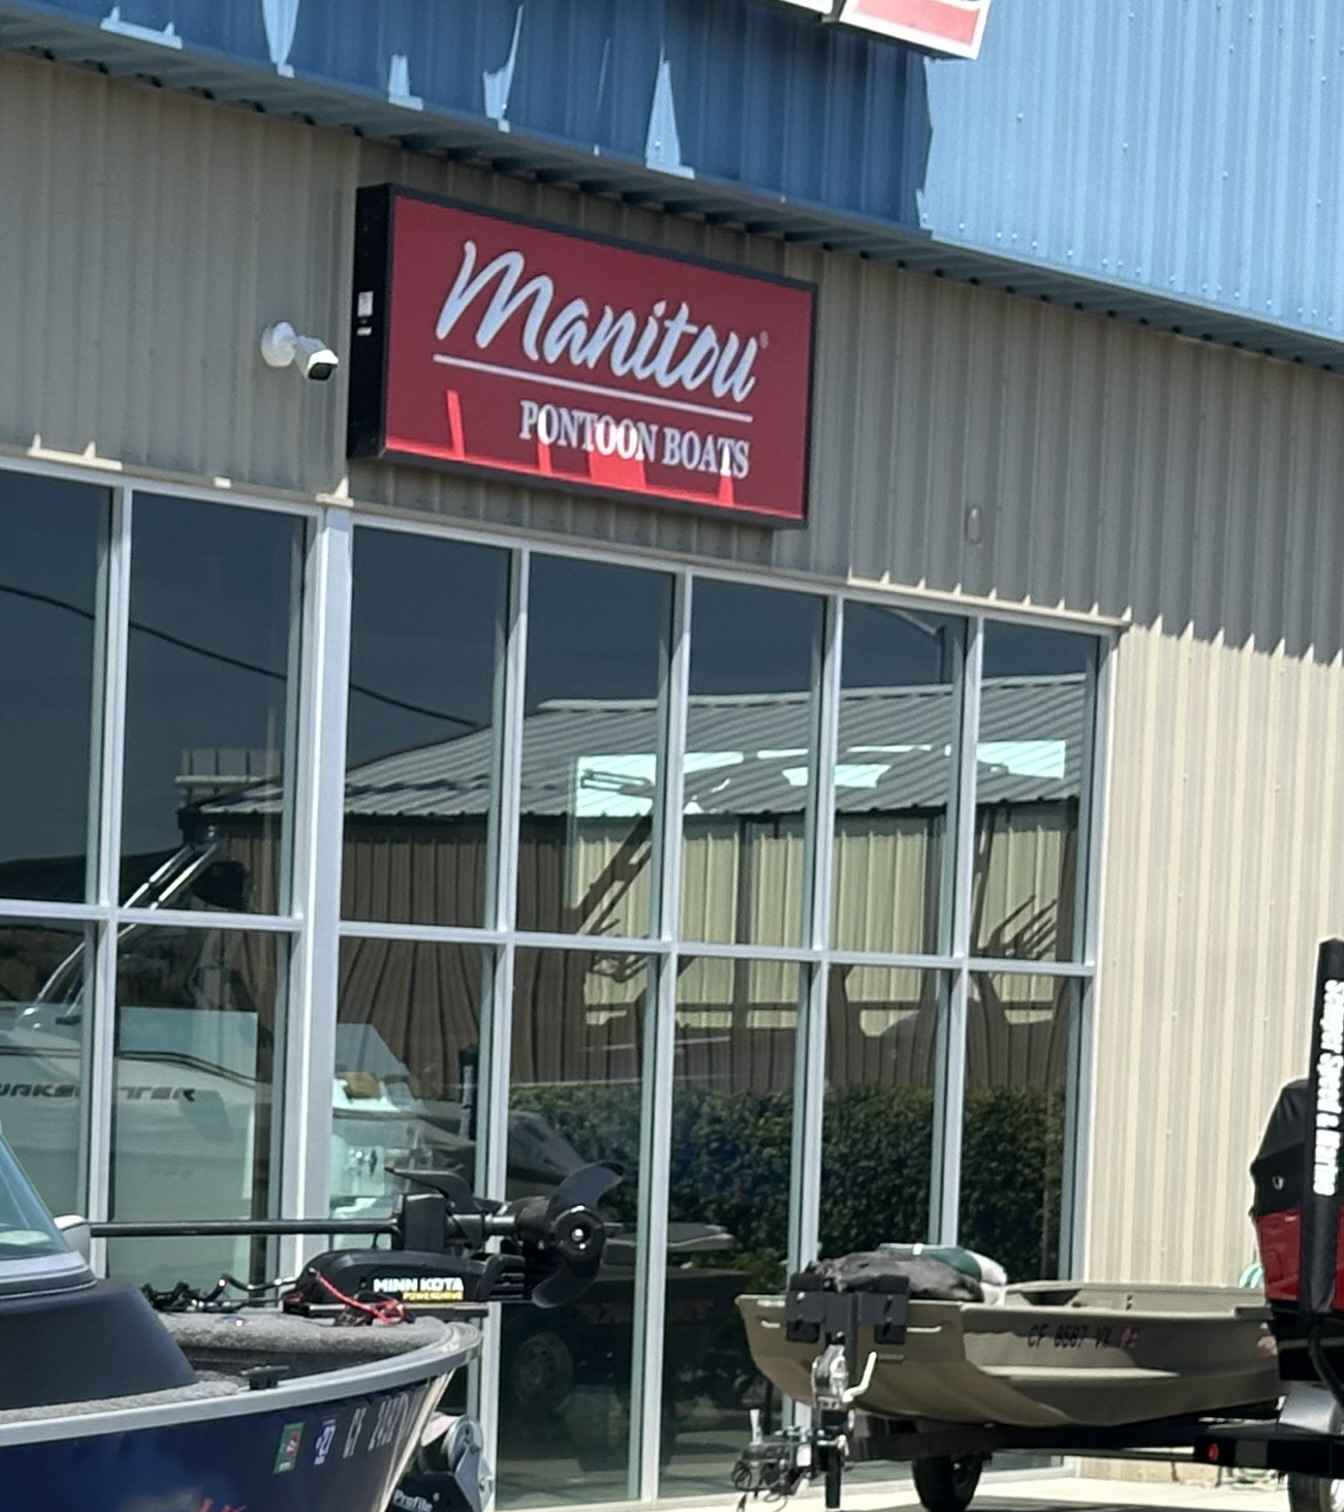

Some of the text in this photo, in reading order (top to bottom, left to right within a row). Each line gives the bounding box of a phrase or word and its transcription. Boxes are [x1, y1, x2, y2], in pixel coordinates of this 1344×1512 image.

[435, 240, 756, 402] Manitou
[519, 400, 750, 479] PONTOON BOATS
[373, 1276, 464, 1293] MINN KOTA
